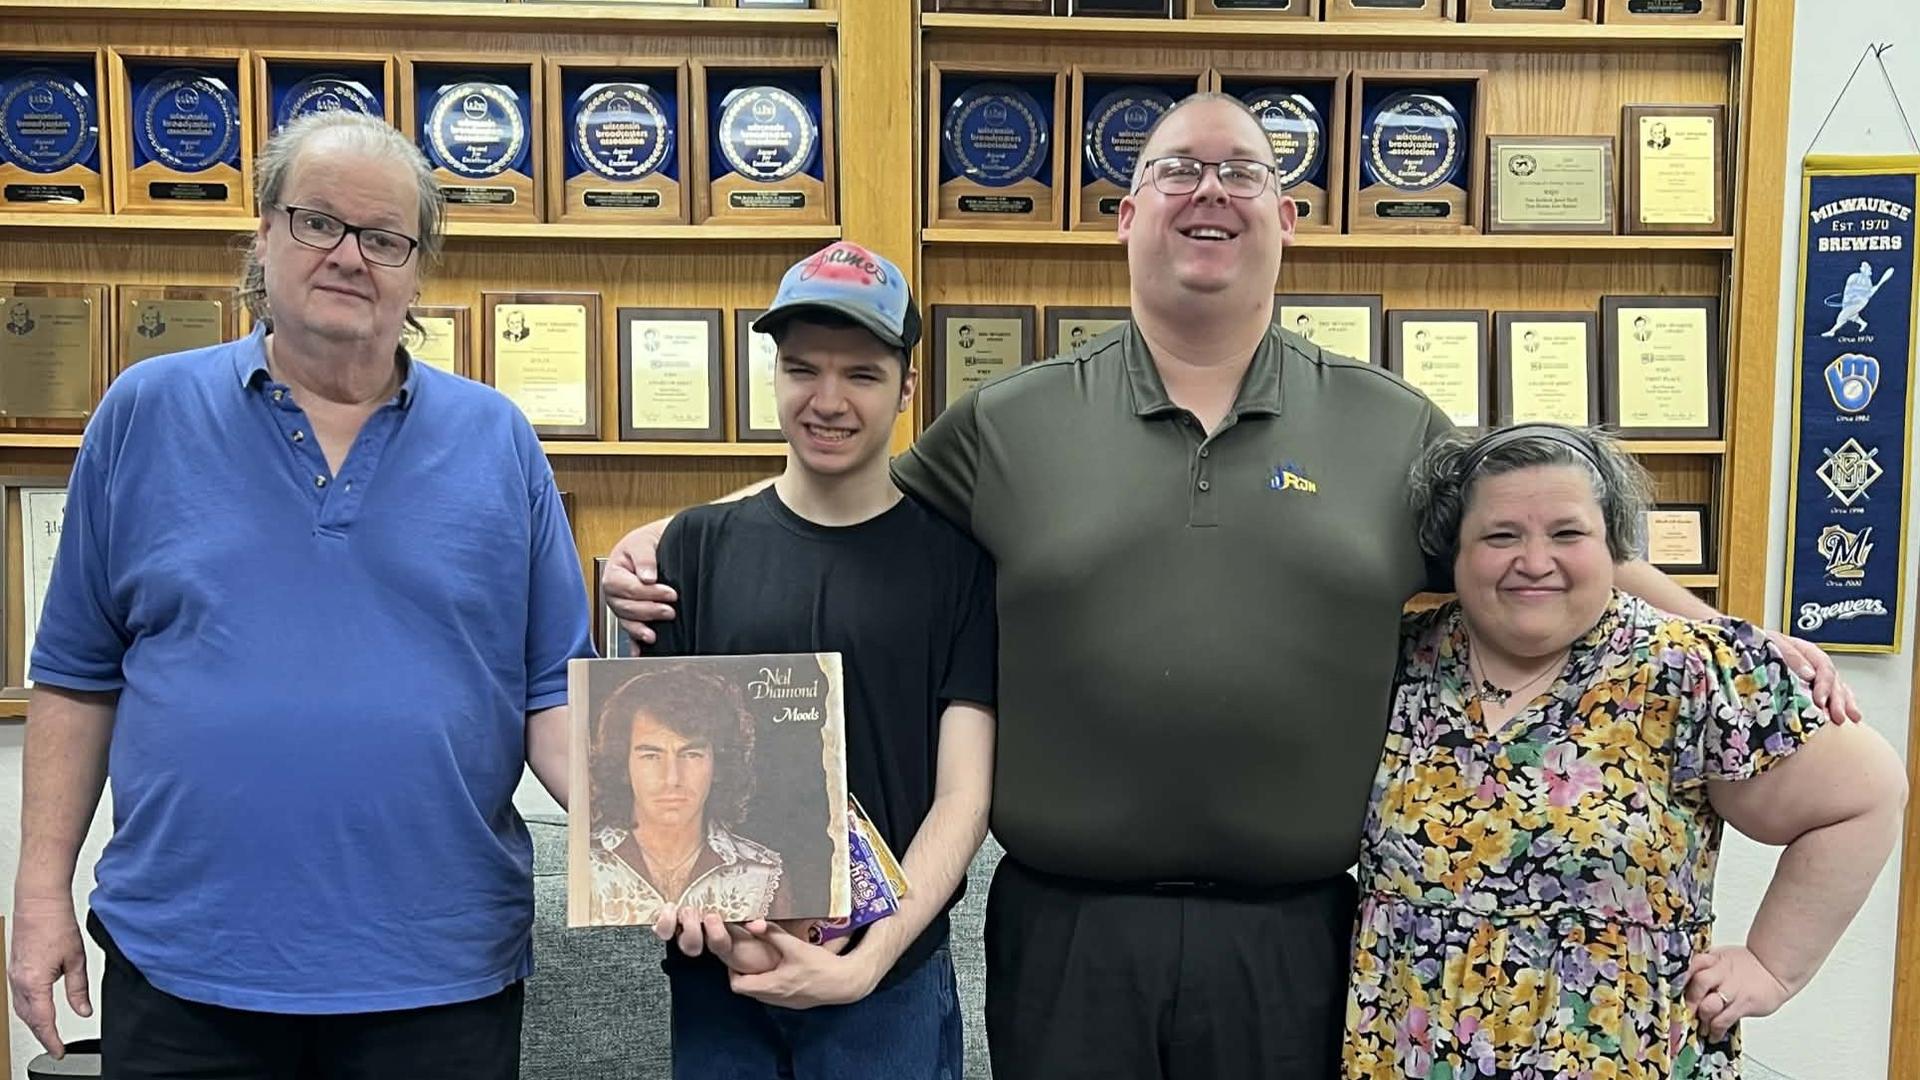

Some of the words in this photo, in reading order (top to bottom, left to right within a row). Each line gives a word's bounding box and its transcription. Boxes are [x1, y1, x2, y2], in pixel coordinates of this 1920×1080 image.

[1389, 140, 1439, 149] broadcasters
[1396, 132, 1432, 140] wisconsin
[1810, 197, 1911, 223] MILWAUKEE
[1861, 219, 1889, 230] 1970
[1818, 236, 1902, 252] BREWERS
[1797, 598, 1887, 630] Brewers
[759, 667, 792, 685] Neil
[747, 680, 818, 699] Diamond
[773, 706, 819, 723] Moods
